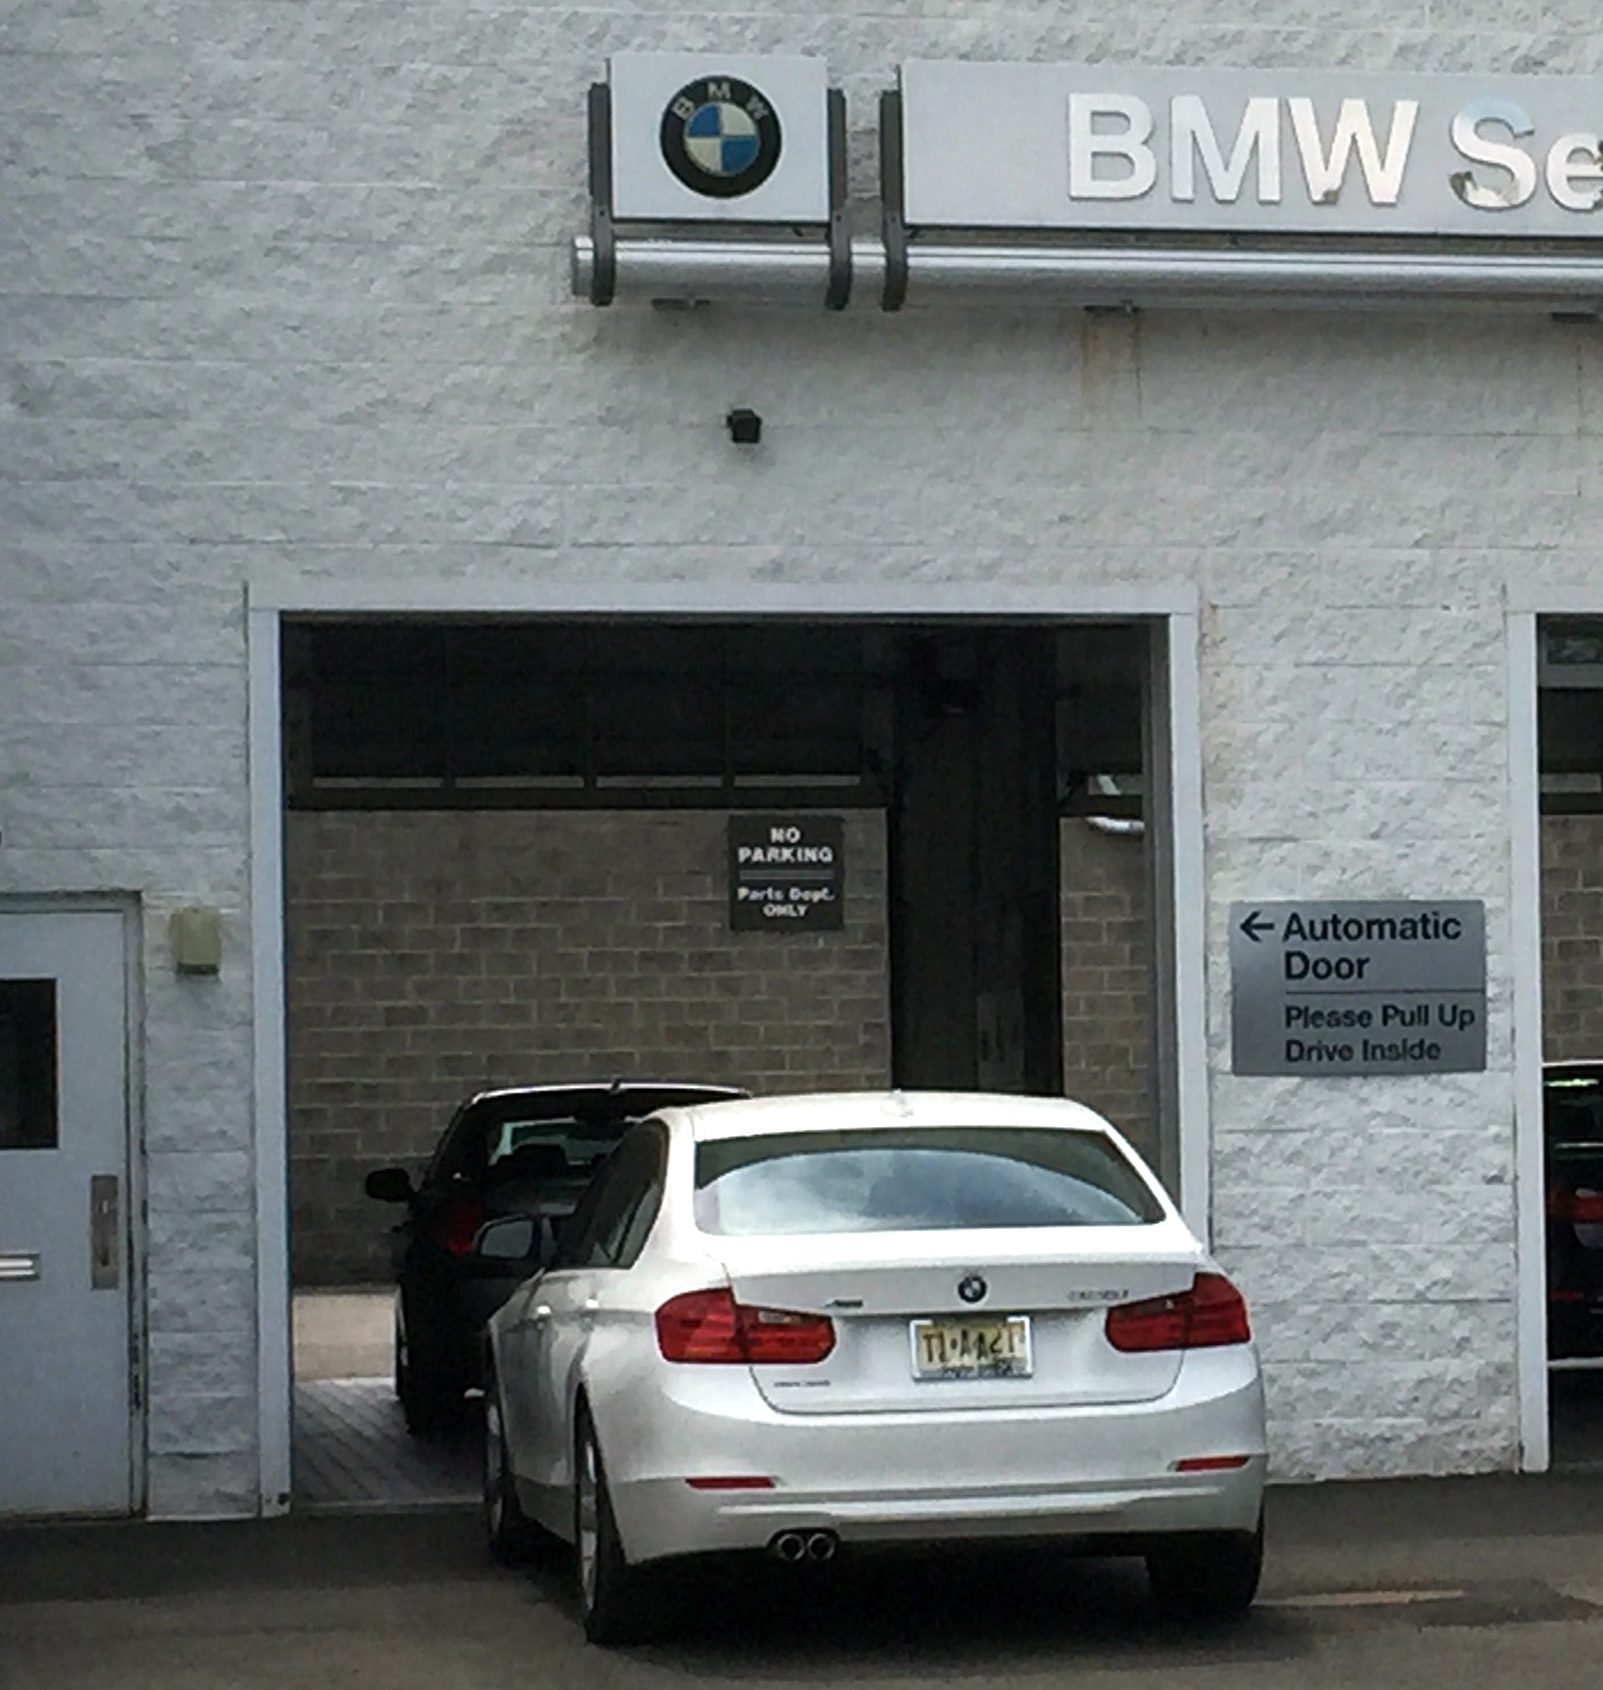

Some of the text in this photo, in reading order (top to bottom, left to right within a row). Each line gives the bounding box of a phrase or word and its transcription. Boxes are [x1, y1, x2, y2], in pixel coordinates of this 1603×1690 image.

[671, 81, 770, 121] BMW
[1066, 92, 1419, 206] BMW
[769, 825, 801, 844] NO
[737, 847, 834, 864] PARKING
[737, 886, 835, 903] Parts Dept.
[762, 903, 810, 917] ONLY
[1282, 911, 1463, 943] Automatic
[1284, 950, 1370, 981] Door
[1284, 1003, 1476, 1031] Please Pull Up
[1284, 1037, 1443, 1063] Drive Inside
